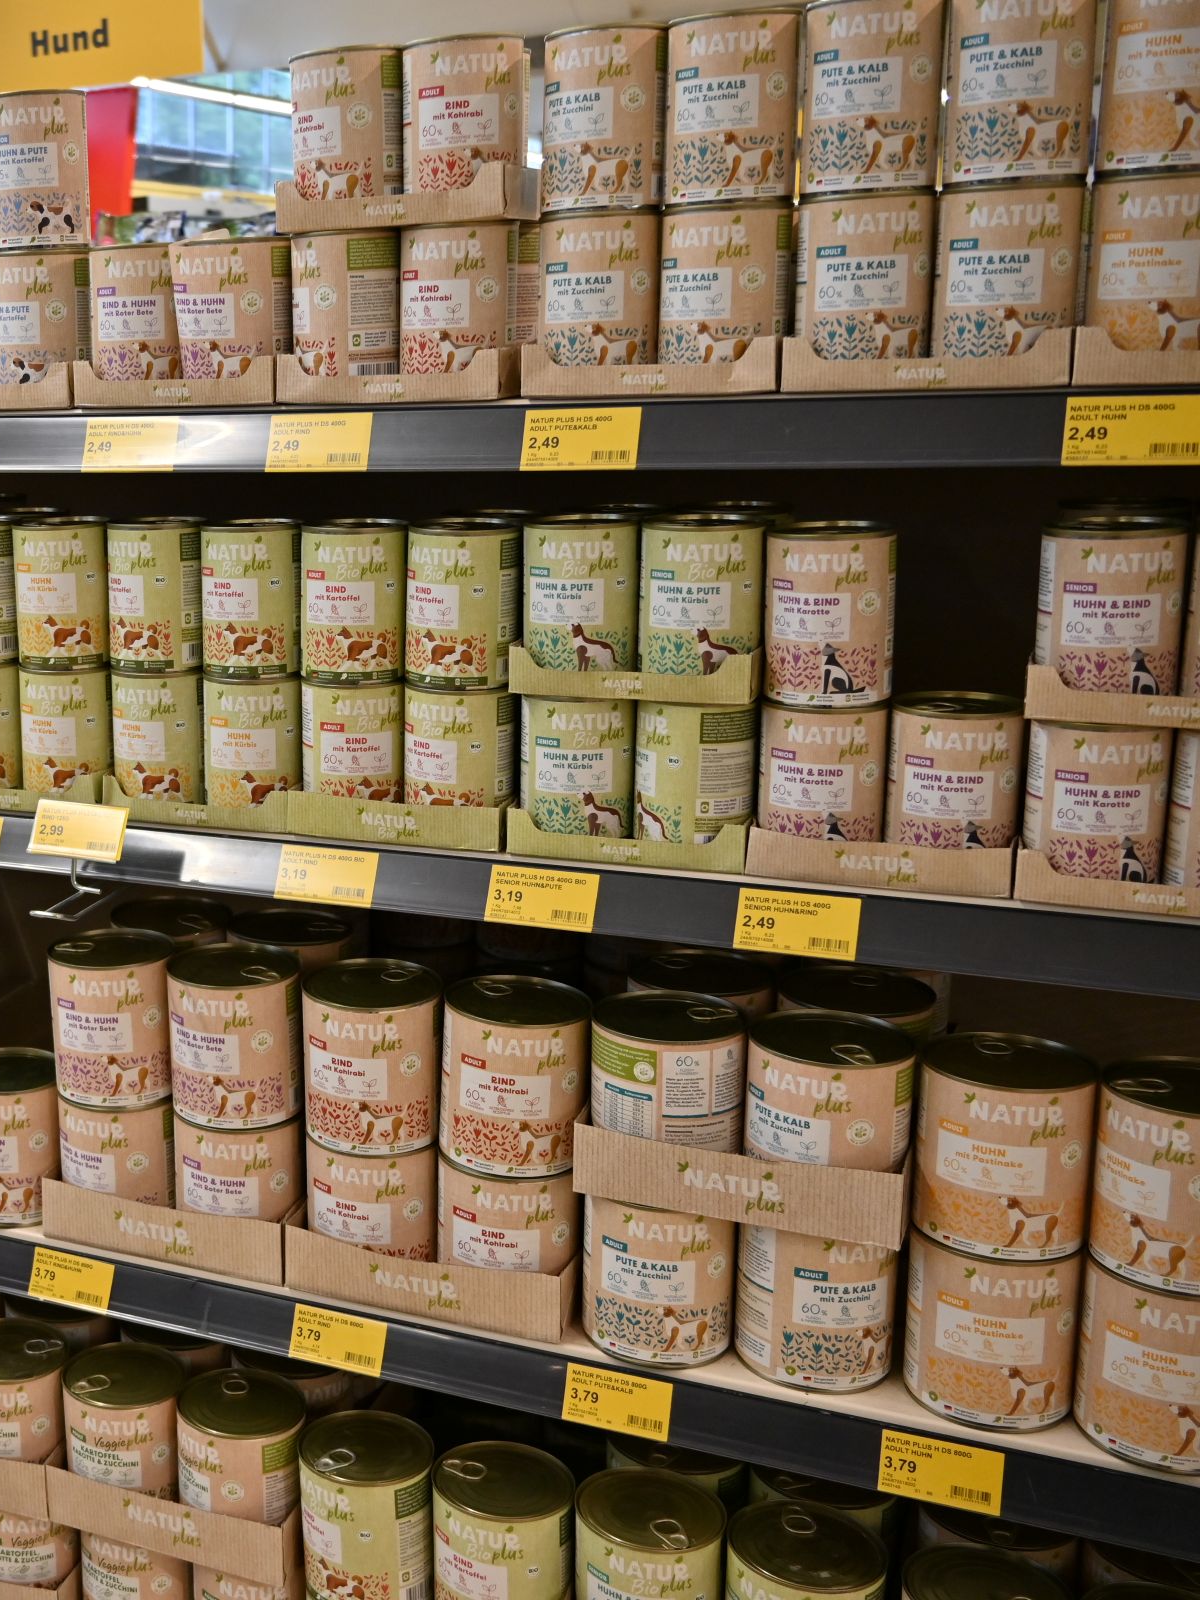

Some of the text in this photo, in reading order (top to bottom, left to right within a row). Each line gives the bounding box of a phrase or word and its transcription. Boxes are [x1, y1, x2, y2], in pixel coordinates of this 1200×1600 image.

[31, 19, 109, 57] Hund
[683, 80, 746, 95] PUTE & KALB
[687, 92, 738, 104] mit Zucchini
[445, 100, 470, 110] RIND
[1128, 247, 1163, 258] HUHN
[827, 260, 896, 272] PUTE & KALB
[833, 271, 888, 282] mit Zucchini
[1068, 427, 1108, 441] 2,49
[87, 442, 111, 453] 2,49
[272, 440, 299, 453] 2,49
[529, 437, 559, 451] 2,49
[1087, 552, 1174, 574] NATUR
[657, 585, 720, 595] HUHN & PUTE
[1065, 584, 1094, 592] SENIOR
[682, 595, 708, 604] Kürbis
[1074, 599, 1151, 609] HUHN & RIND
[1102, 611, 1140, 619] Karotte
[346, 737, 367, 745] RIND
[913, 772, 984, 785] HUHN & RIND
[921, 783, 973, 793] mit Karotte
[40, 824, 63, 836] 2,99
[281, 868, 306, 880] 3,19
[497, 871, 519, 879] NATUR
[522, 881, 562, 890] HUHN&PUTE
[493, 890, 522, 903] 3,19
[744, 903, 818, 915] SENIOR HUHN&RIND
[813, 901, 831, 909] 400G
[743, 915, 775, 929] 2,49
[66, 1013, 83, 1022] RIND
[94, 1016, 118, 1024] HUHN
[80, 1023, 97, 1031] Roter
[325, 1021, 398, 1041] NATUR
[332, 1058, 352, 1067] RIND
[972, 1144, 1007, 1157] HUHN
[684, 1169, 781, 1201] NATUR
[745, 1191, 785, 1215] plus
[35, 1267, 55, 1281] 3,79
[800, 1270, 823, 1279] ADULT
[375, 1269, 457, 1299] NATUR
[814, 1284, 876, 1294] PUTE & KALB
[820, 1294, 870, 1303] mit Zucchini
[299, 1310, 318, 1318] NATUR
[298, 1316, 331, 1328] ADULT RIND
[296, 1326, 320, 1341] 3,79
[572, 1369, 594, 1379] NATUR
[596, 1374, 613, 1382] PLUS
[571, 1377, 634, 1394] ADULT PUTE&KALB
[570, 1387, 599, 1403] 3,79
[885, 1444, 932, 1459] ADULT HUHN
[886, 1436, 910, 1446] NATUR
[912, 1440, 932, 1449] PLUS
[942, 1447, 951, 1455] DS
[954, 1450, 972, 1458] 800G
[884, 1456, 916, 1473] 3,79
